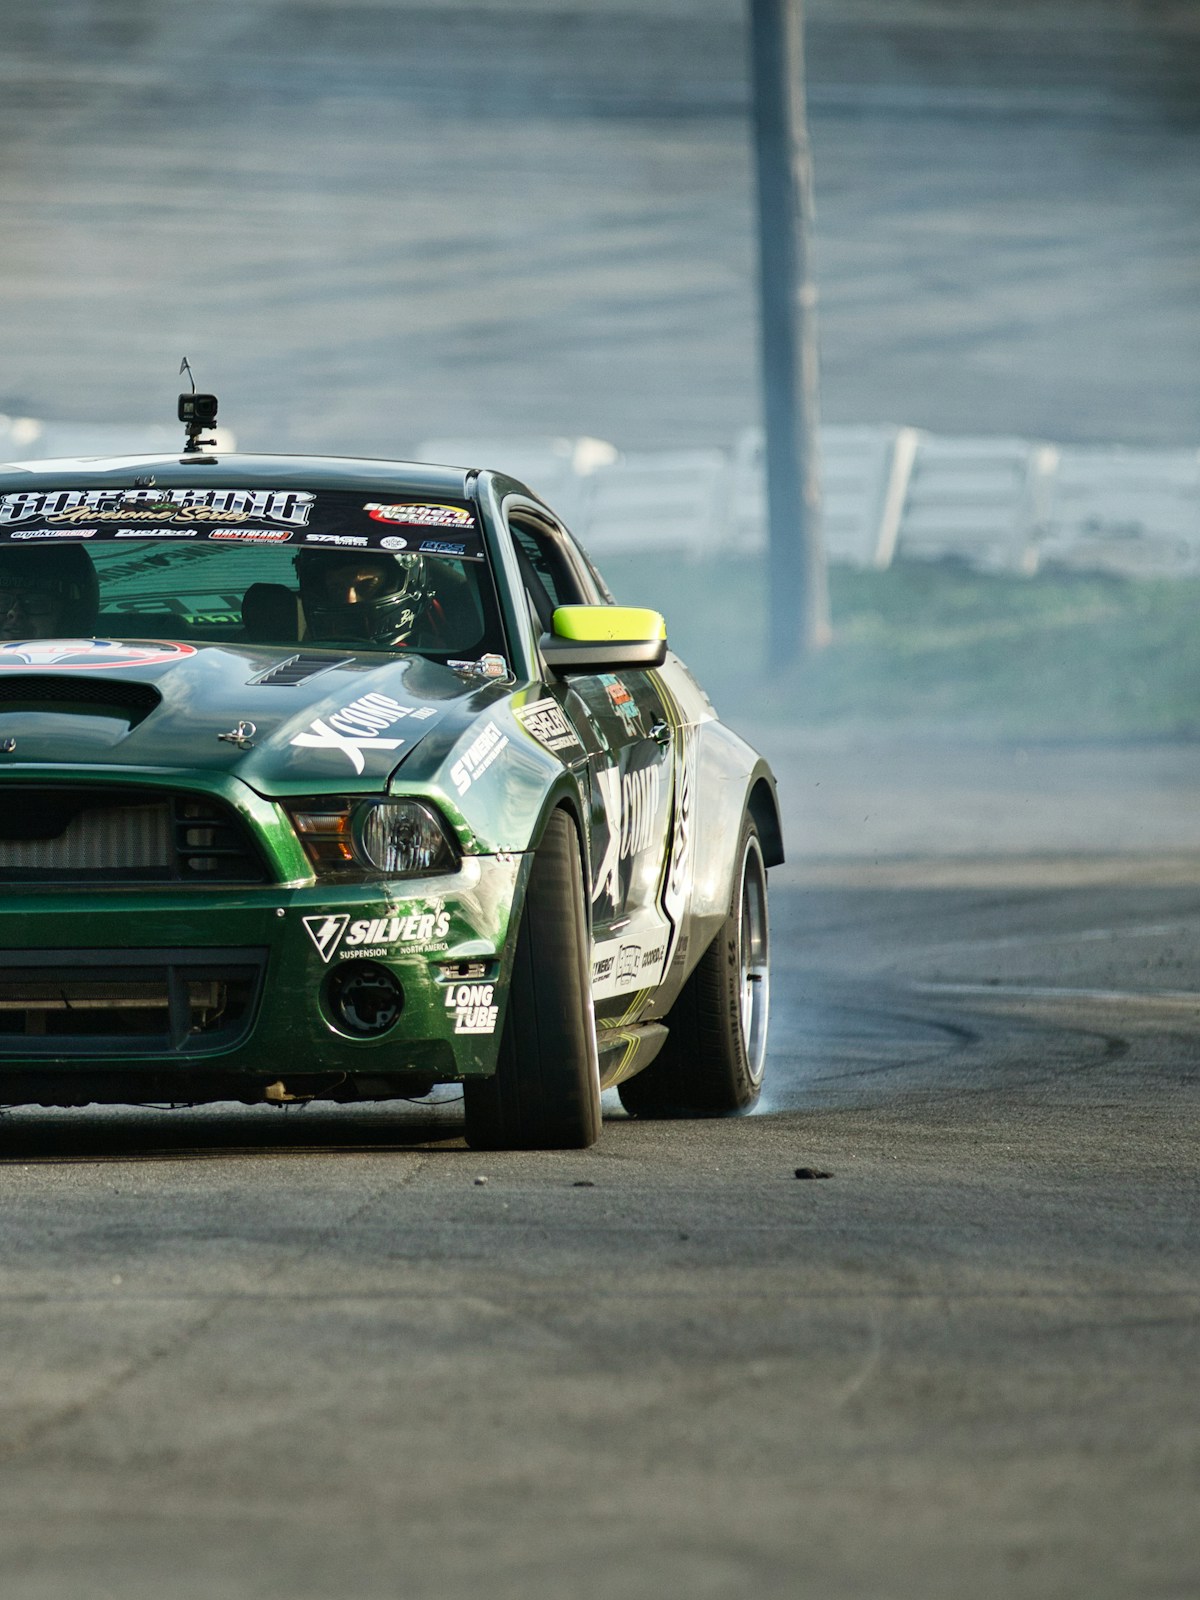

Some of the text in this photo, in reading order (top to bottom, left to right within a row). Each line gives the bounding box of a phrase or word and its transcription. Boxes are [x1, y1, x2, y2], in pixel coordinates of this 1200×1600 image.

[49, 505, 250, 522] Awesome Series
[363, 503, 470, 519] Southern
[377, 511, 475, 524] National
[114, 529, 198, 537] FuelTech
[306, 534, 368, 542] STAGE
[339, 941, 449, 959] SUSPENSION NORTH AMERICA
[445, 985, 494, 1007] LONG
[455, 1006, 498, 1027] TUBE
